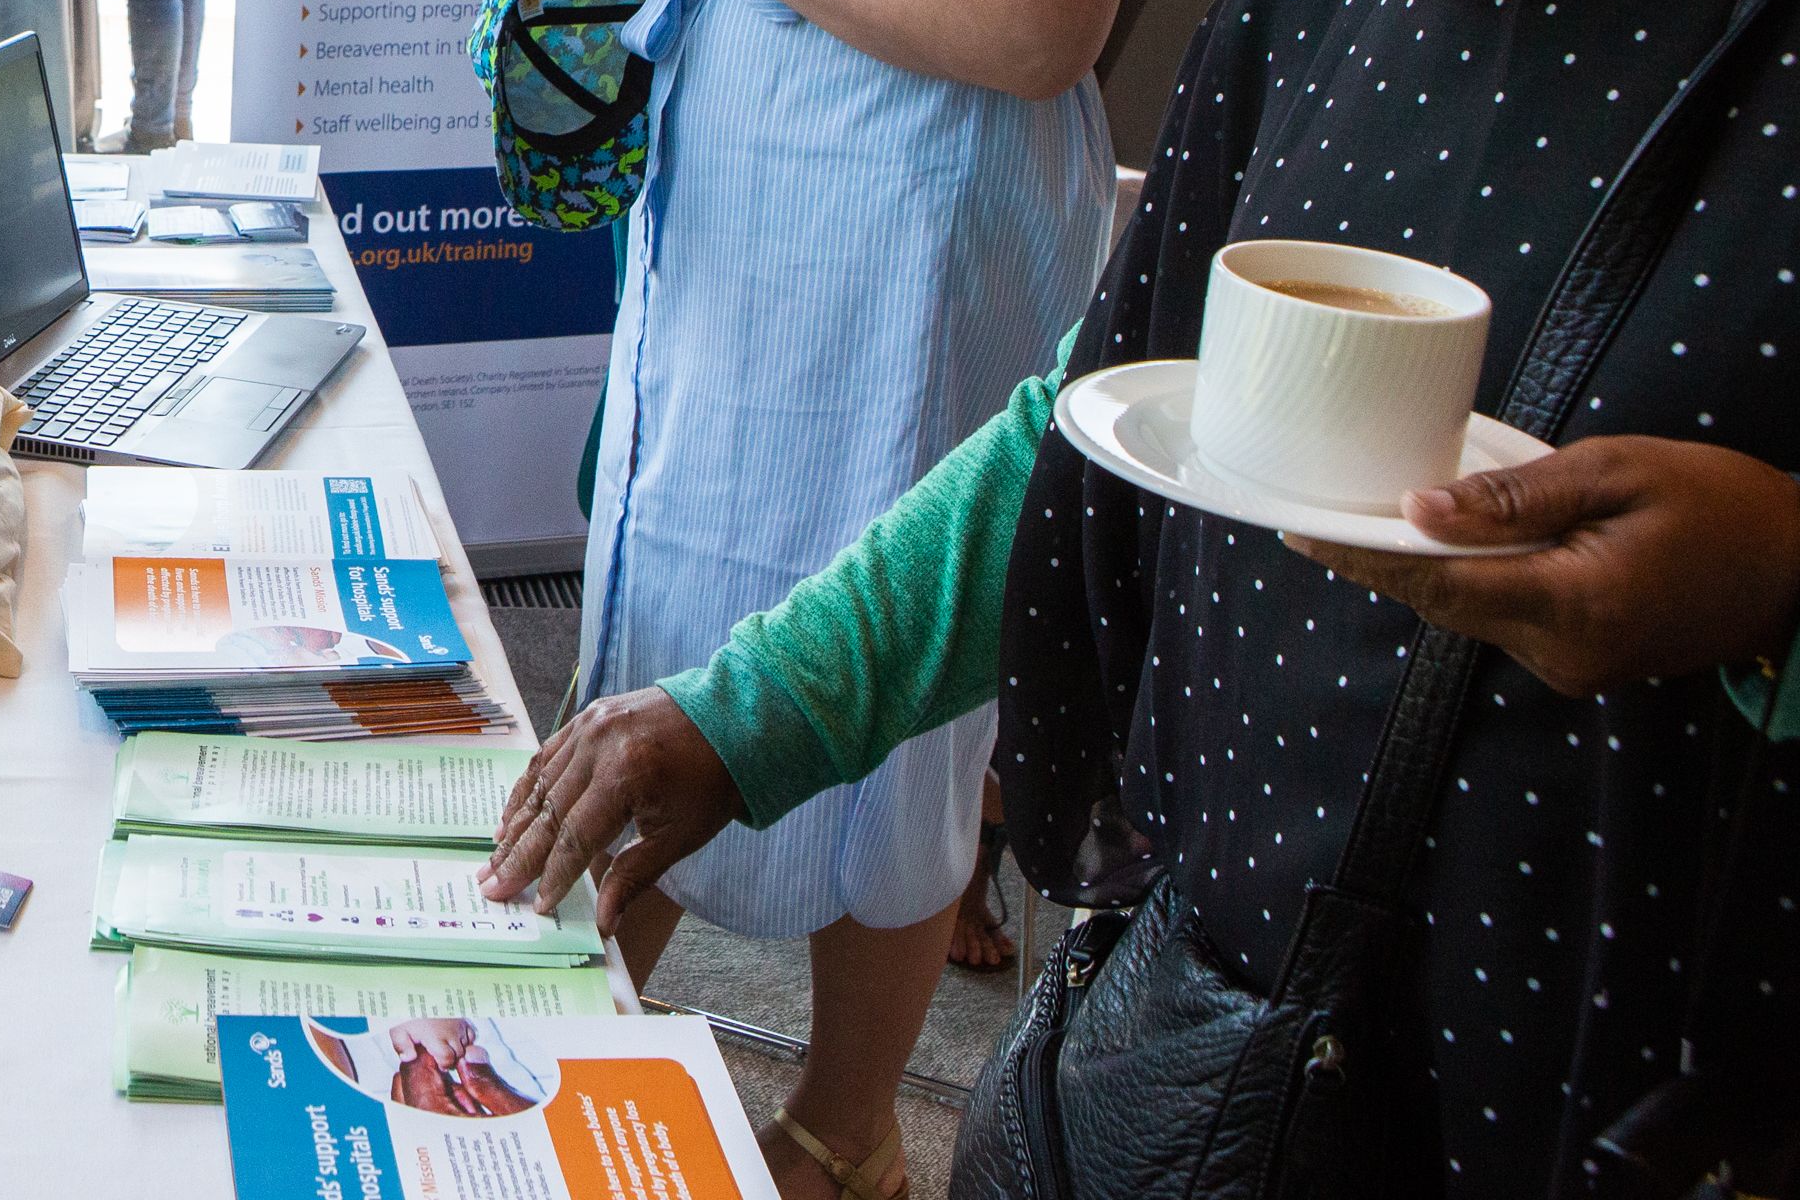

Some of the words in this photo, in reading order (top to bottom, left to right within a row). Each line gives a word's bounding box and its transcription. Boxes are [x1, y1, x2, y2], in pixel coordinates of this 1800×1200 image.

[318, 3, 417, 25] Supporting
[422, 3, 482, 23] pregna
[315, 39, 430, 60] Bereavement
[435, 40, 453, 56] in
[313, 78, 374, 98] Mental
[378, 76, 435, 94] health
[312, 115, 351, 135] Staff
[355, 115, 441, 134] wellbeing
[446, 113, 479, 130] and
[373, 204, 431, 234] out
[348, 566, 364, 581] for
[373, 566, 392, 599] Sands'
[348, 581, 377, 622] hospitals
[378, 597, 405, 631] support
[418, 633, 436, 654] Sands
[267, 1049, 287, 1089] Sands
[606, 1107, 628, 1146] anyone
[623, 1099, 640, 1121] loss
[304, 1105, 340, 1175] support
[631, 1121, 663, 1177] pregnancy
[344, 1126, 382, 1200] ospitals
[415, 1146, 439, 1194] Mission
[617, 1146, 643, 1187] support
